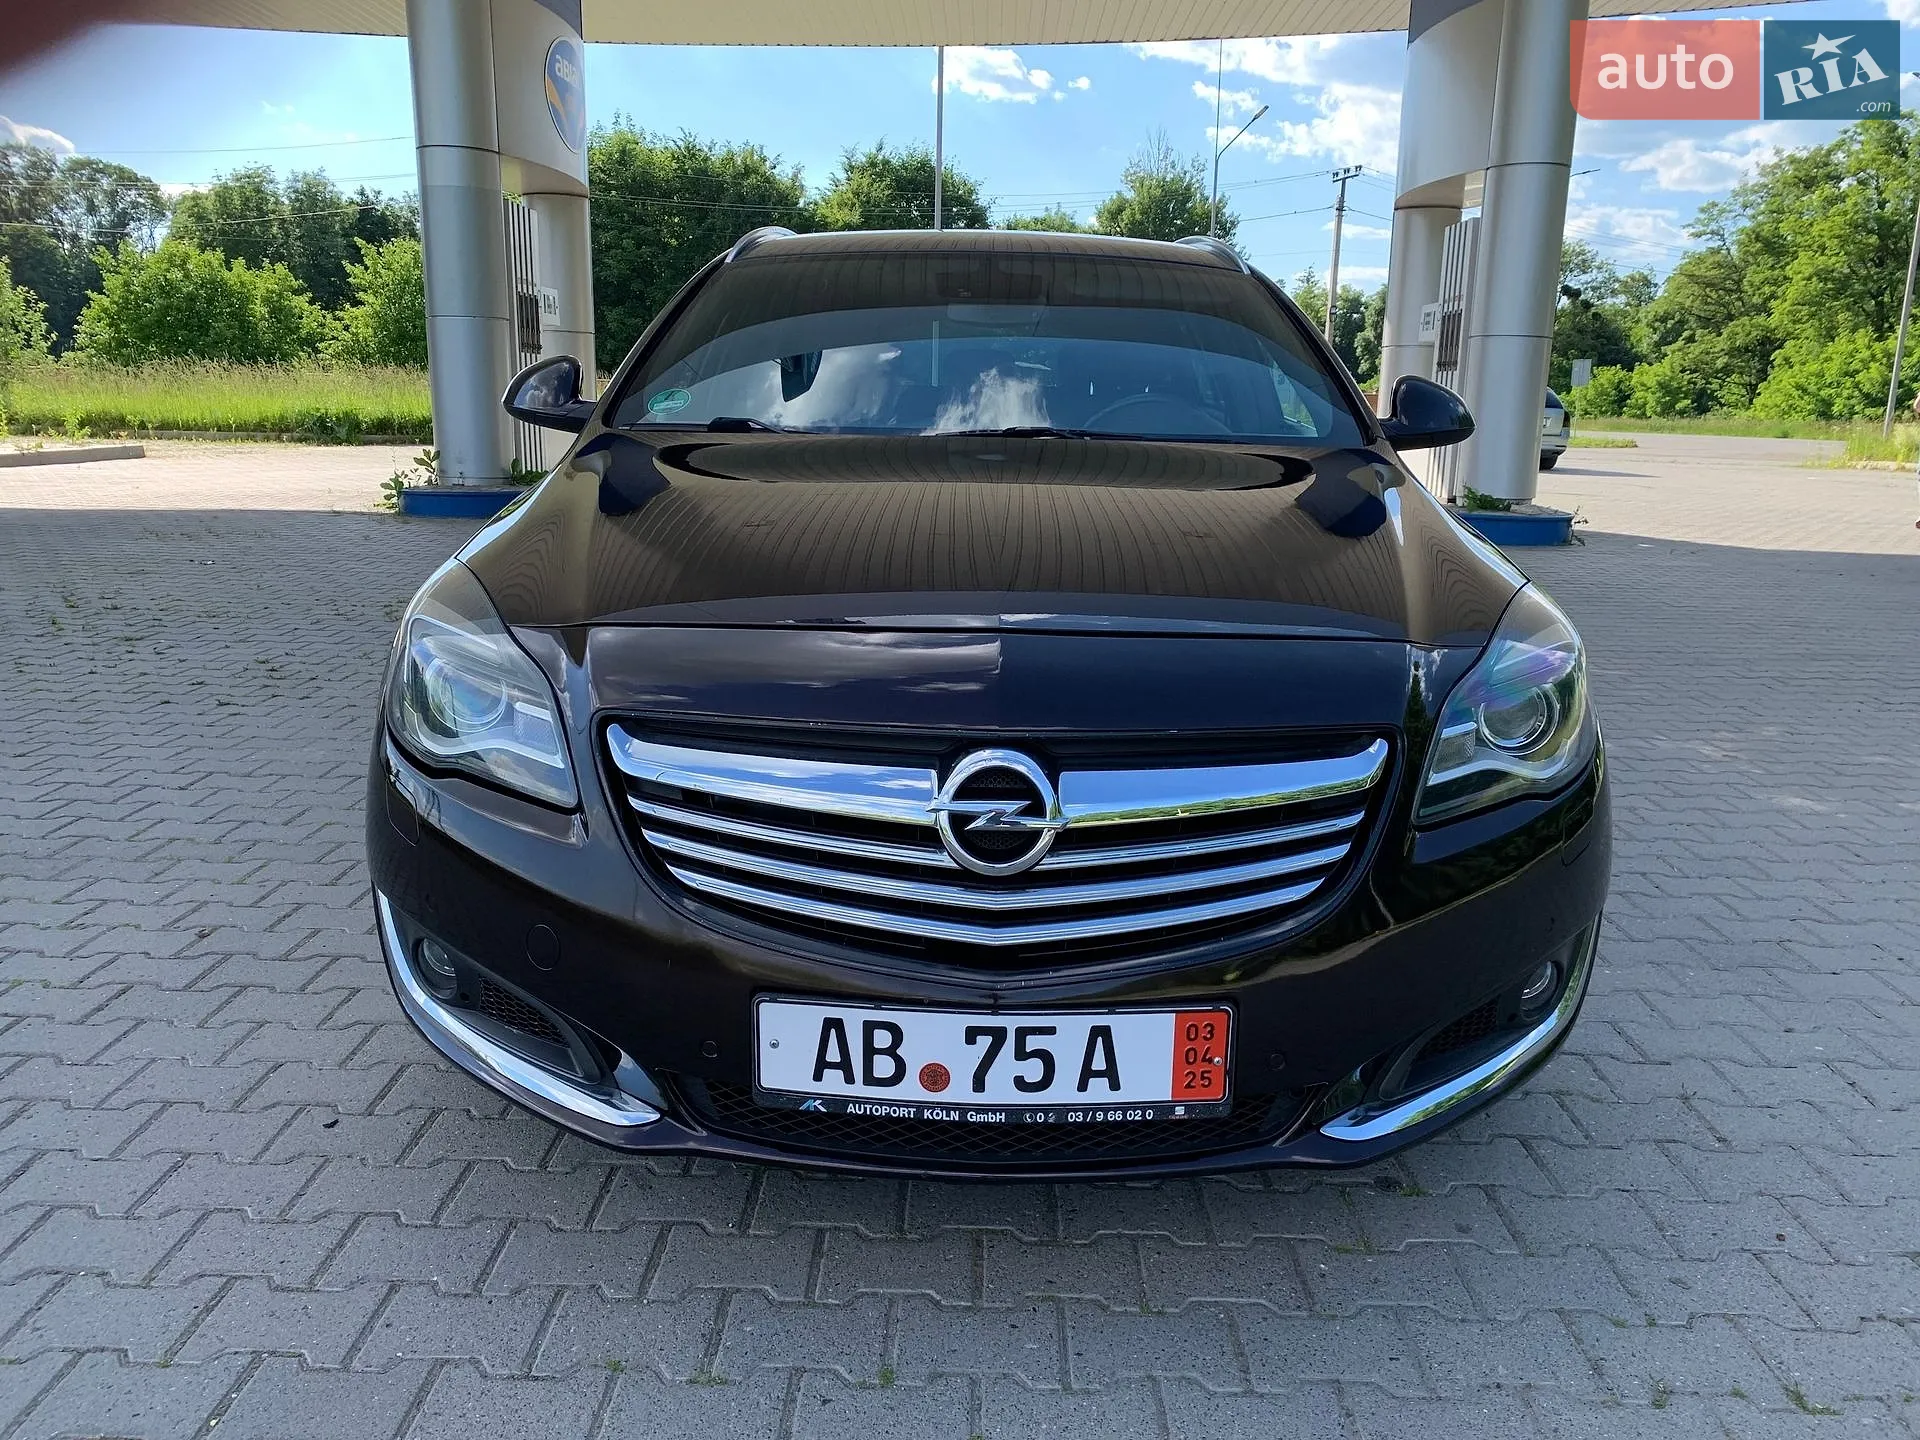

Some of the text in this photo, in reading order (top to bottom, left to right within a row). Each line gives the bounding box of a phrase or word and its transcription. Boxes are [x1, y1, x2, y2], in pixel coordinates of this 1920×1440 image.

[1185, 1022, 1216, 1041] 03
[812, 1016, 907, 1087] AB
[964, 1025, 1057, 1093] 75
[1076, 1025, 1121, 1092] A
[1184, 1045, 1214, 1065] 04
[1183, 1069, 1213, 1089] 25
[846, 1103, 917, 1118] AUTOPORT
[923, 1108, 960, 1121] KÖLN
[966, 1111, 1006, 1123] GmbH
